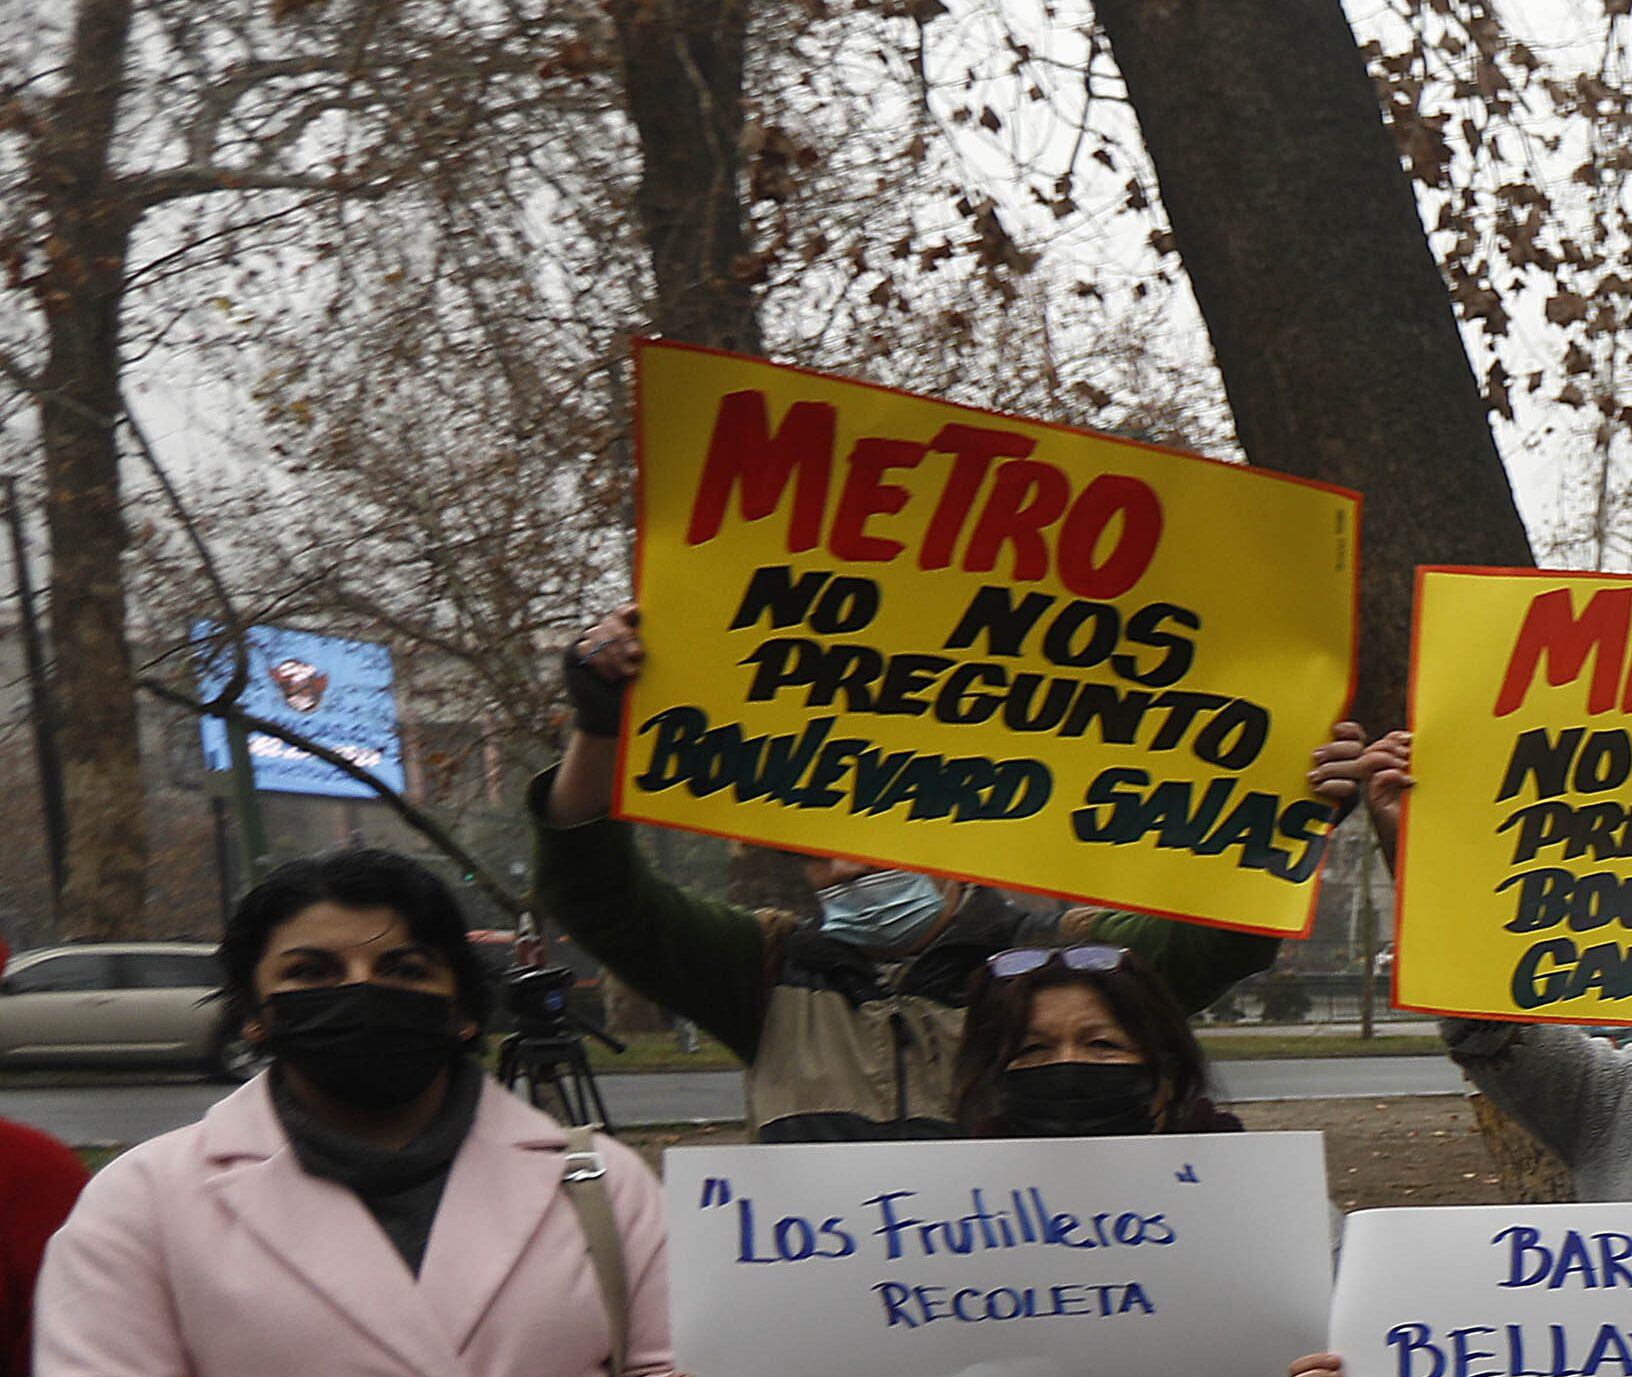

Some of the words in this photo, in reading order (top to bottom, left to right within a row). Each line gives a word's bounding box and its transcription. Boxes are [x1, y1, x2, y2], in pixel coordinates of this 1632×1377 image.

[685, 389, 1164, 600] METRO
[728, 565, 883, 635] NO
[942, 586, 1202, 688] NOS
[634, 705, 1053, 823] BOULEVARD
[736, 637, 1272, 771] PREGUNTO
[1495, 727, 1632, 803] NO
[871, 1281, 1156, 1329] RECOLETA
